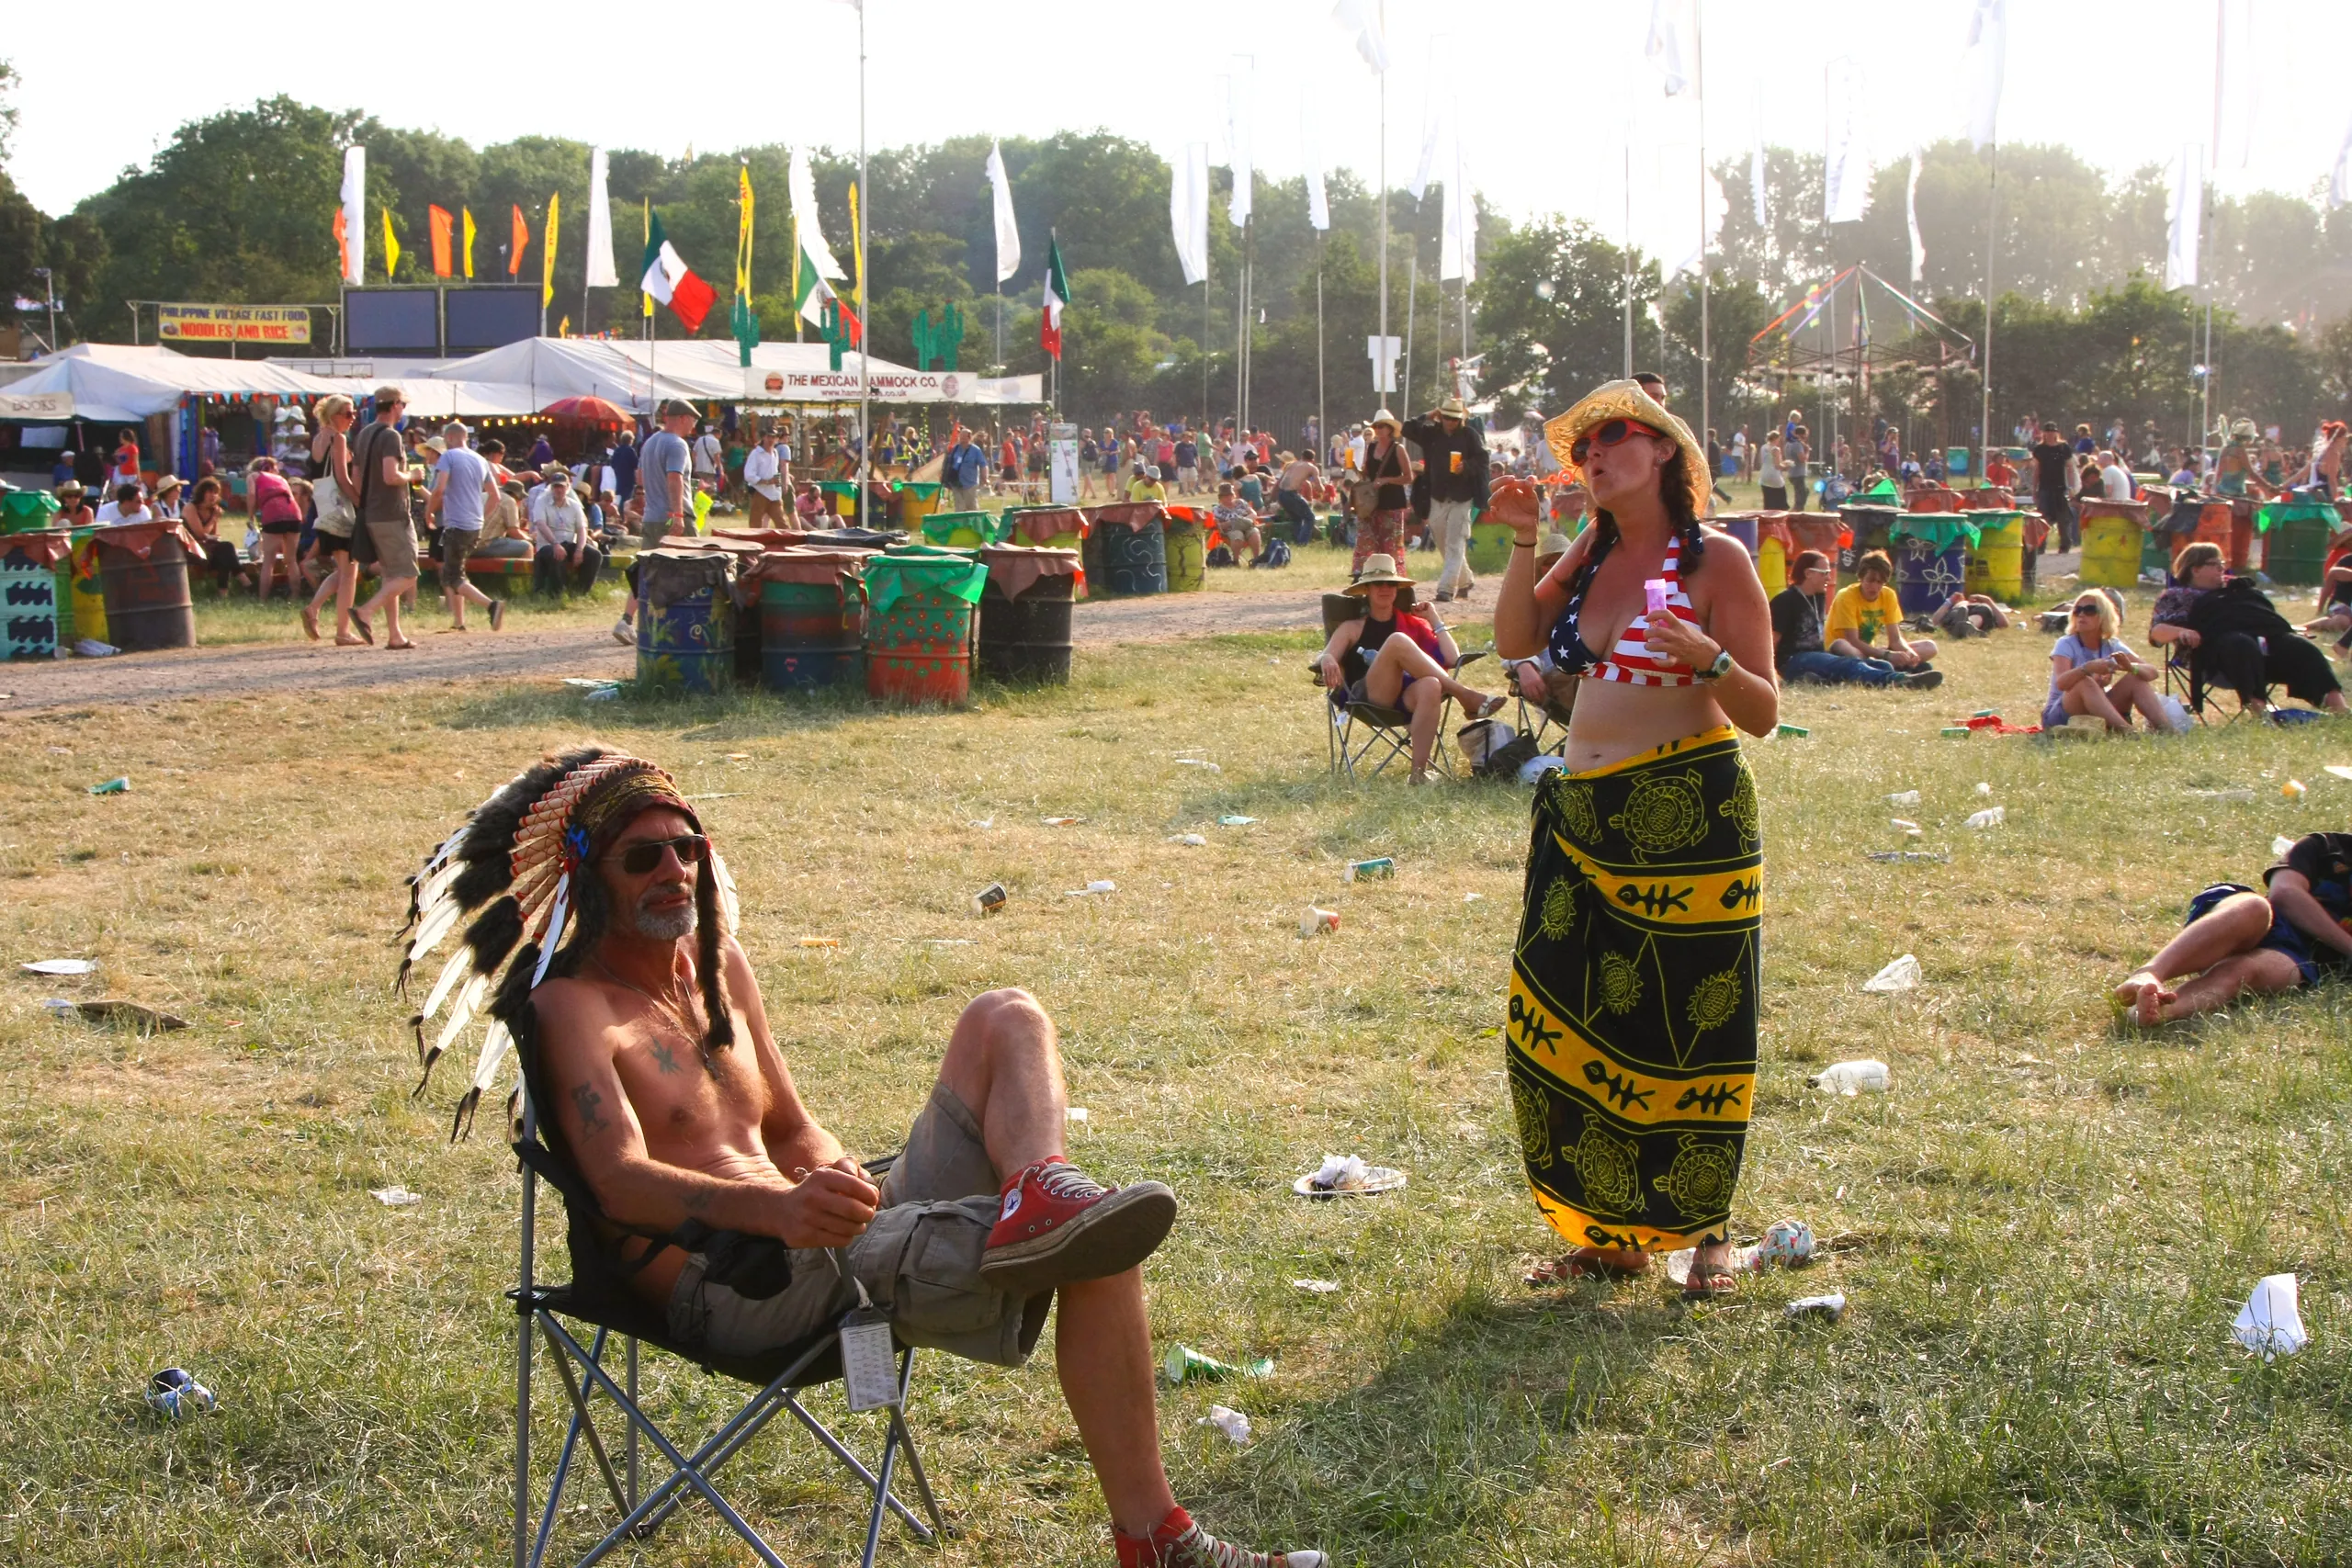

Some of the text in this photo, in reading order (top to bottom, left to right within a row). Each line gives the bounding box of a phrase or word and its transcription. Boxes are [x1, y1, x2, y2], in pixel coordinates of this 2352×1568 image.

[160, 307, 210, 319] PHILIPPINE
[254, 310, 278, 321] FAST
[282, 310, 308, 321] FOOD
[180, 322, 288, 339] NOODLES AND RICE
[787, 375, 939, 387] THE MEXICAN AMMOCK CO.
[12, 399, 57, 412] BOOKS
